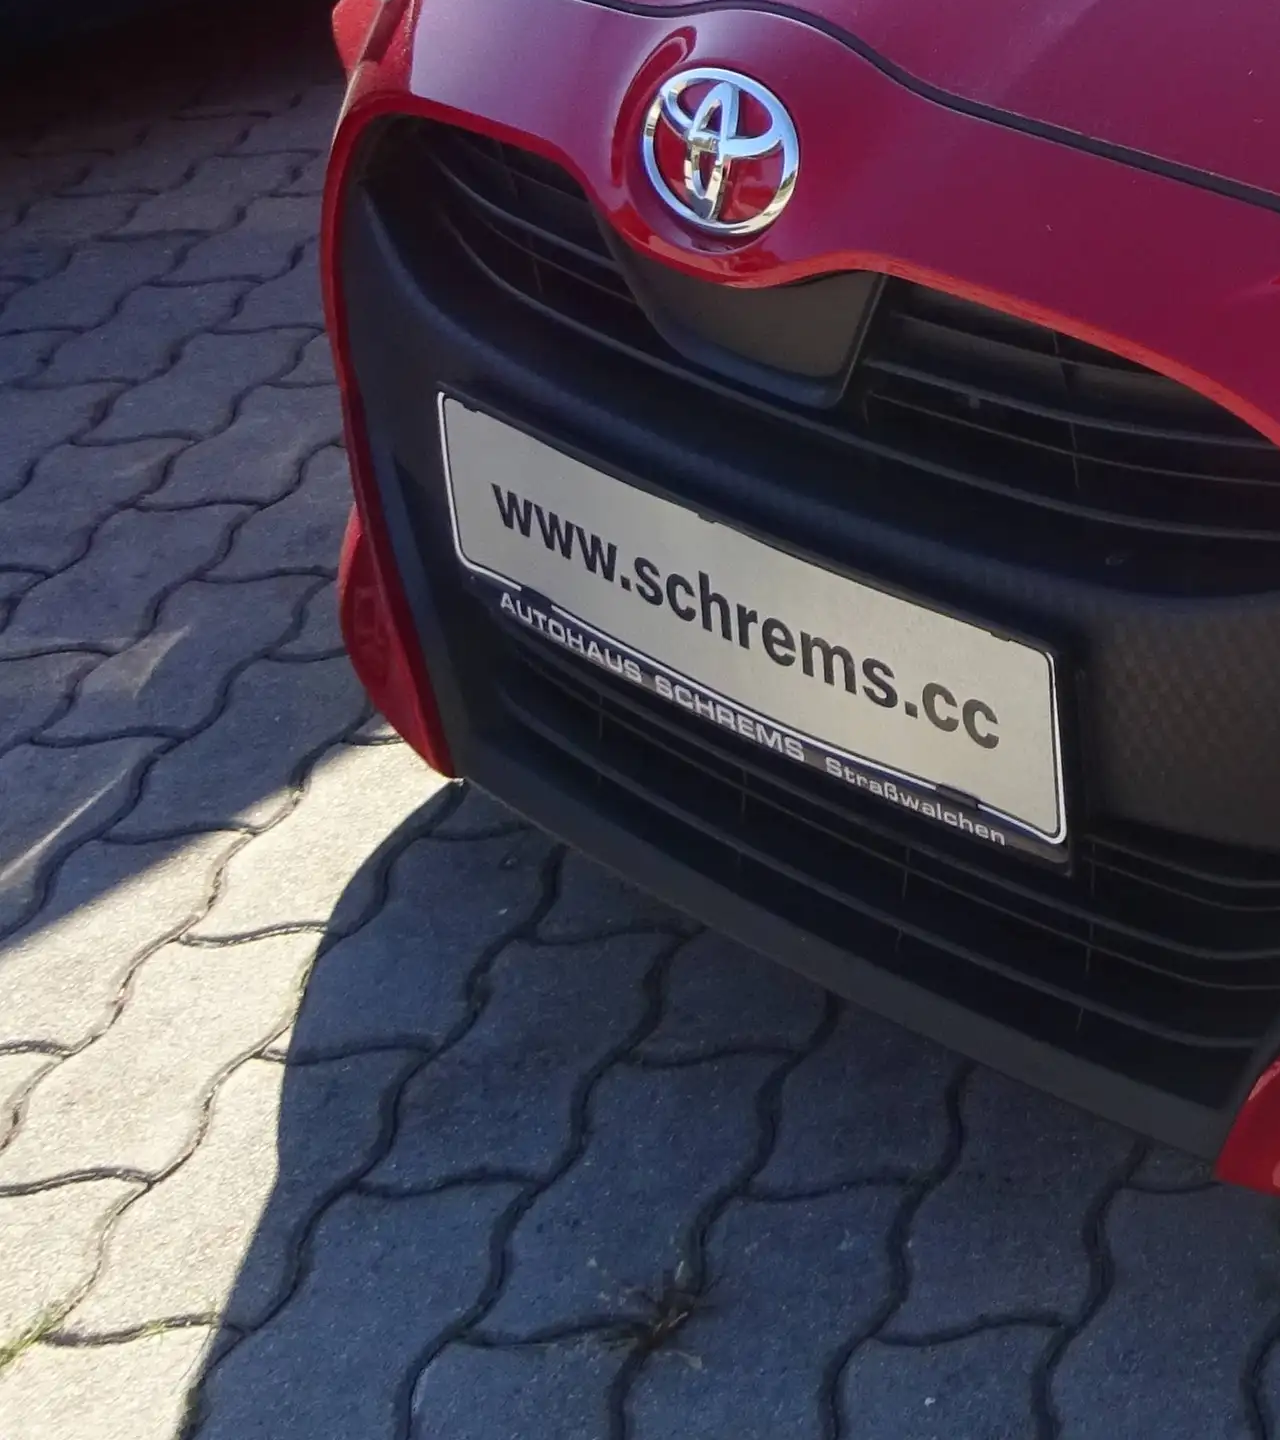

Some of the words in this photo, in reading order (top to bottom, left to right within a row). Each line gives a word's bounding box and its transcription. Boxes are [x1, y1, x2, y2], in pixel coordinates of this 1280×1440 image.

[491, 482, 999, 749] www.schrems.cc
[500, 592, 644, 683] AUTOHAUS
[655, 674, 804, 762] SCHREMS
[825, 756, 1006, 846] Straßwalchen
